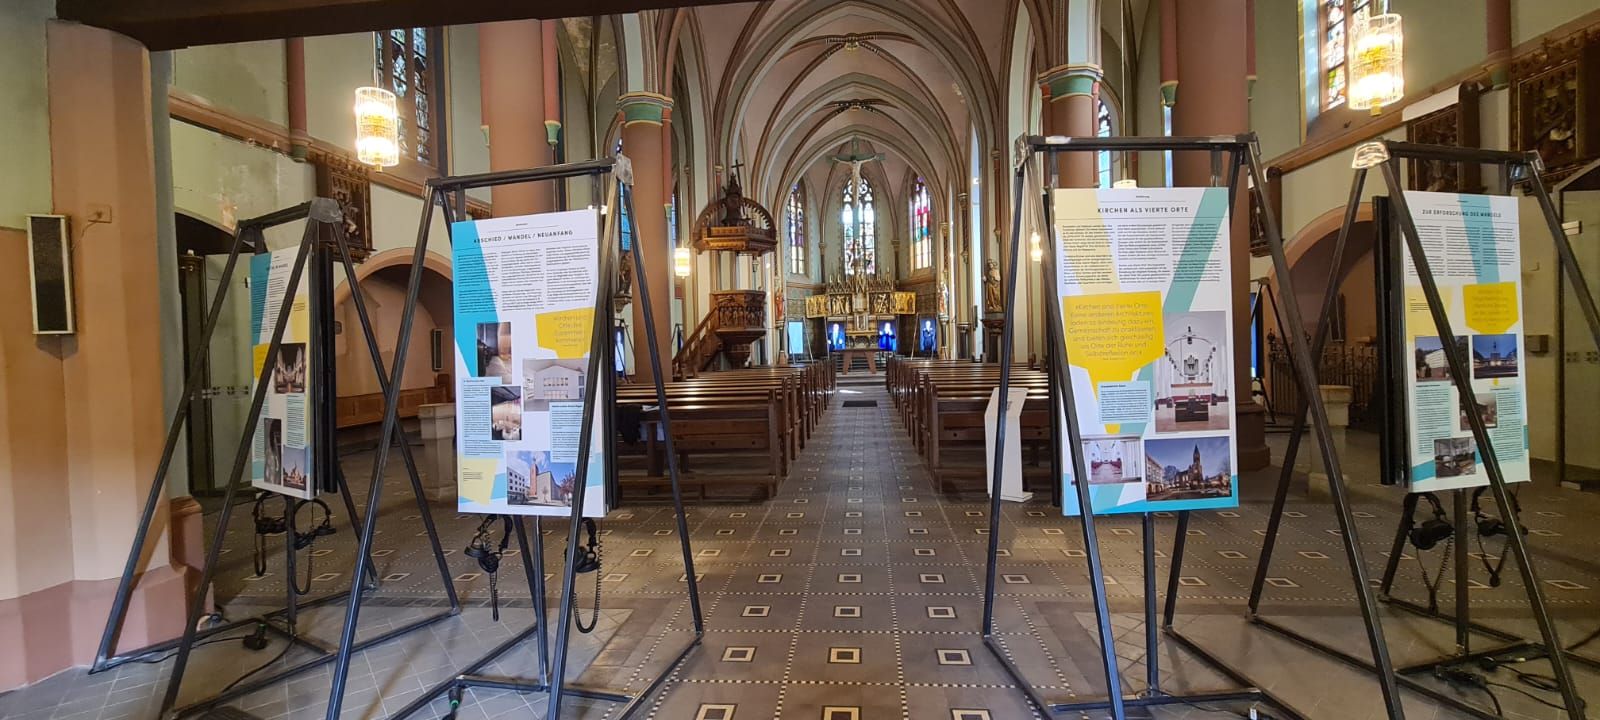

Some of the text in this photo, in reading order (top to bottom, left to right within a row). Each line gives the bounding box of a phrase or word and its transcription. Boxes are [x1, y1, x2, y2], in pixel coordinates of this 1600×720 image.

[1097, 206, 1128, 214] KIRCHEN
[1433, 209, 1469, 217] ERFORSCHUNG
[473, 235, 502, 243] ABSCHIED
[508, 233, 531, 241] WANDEL
[537, 230, 573, 238] NEUANFANG
